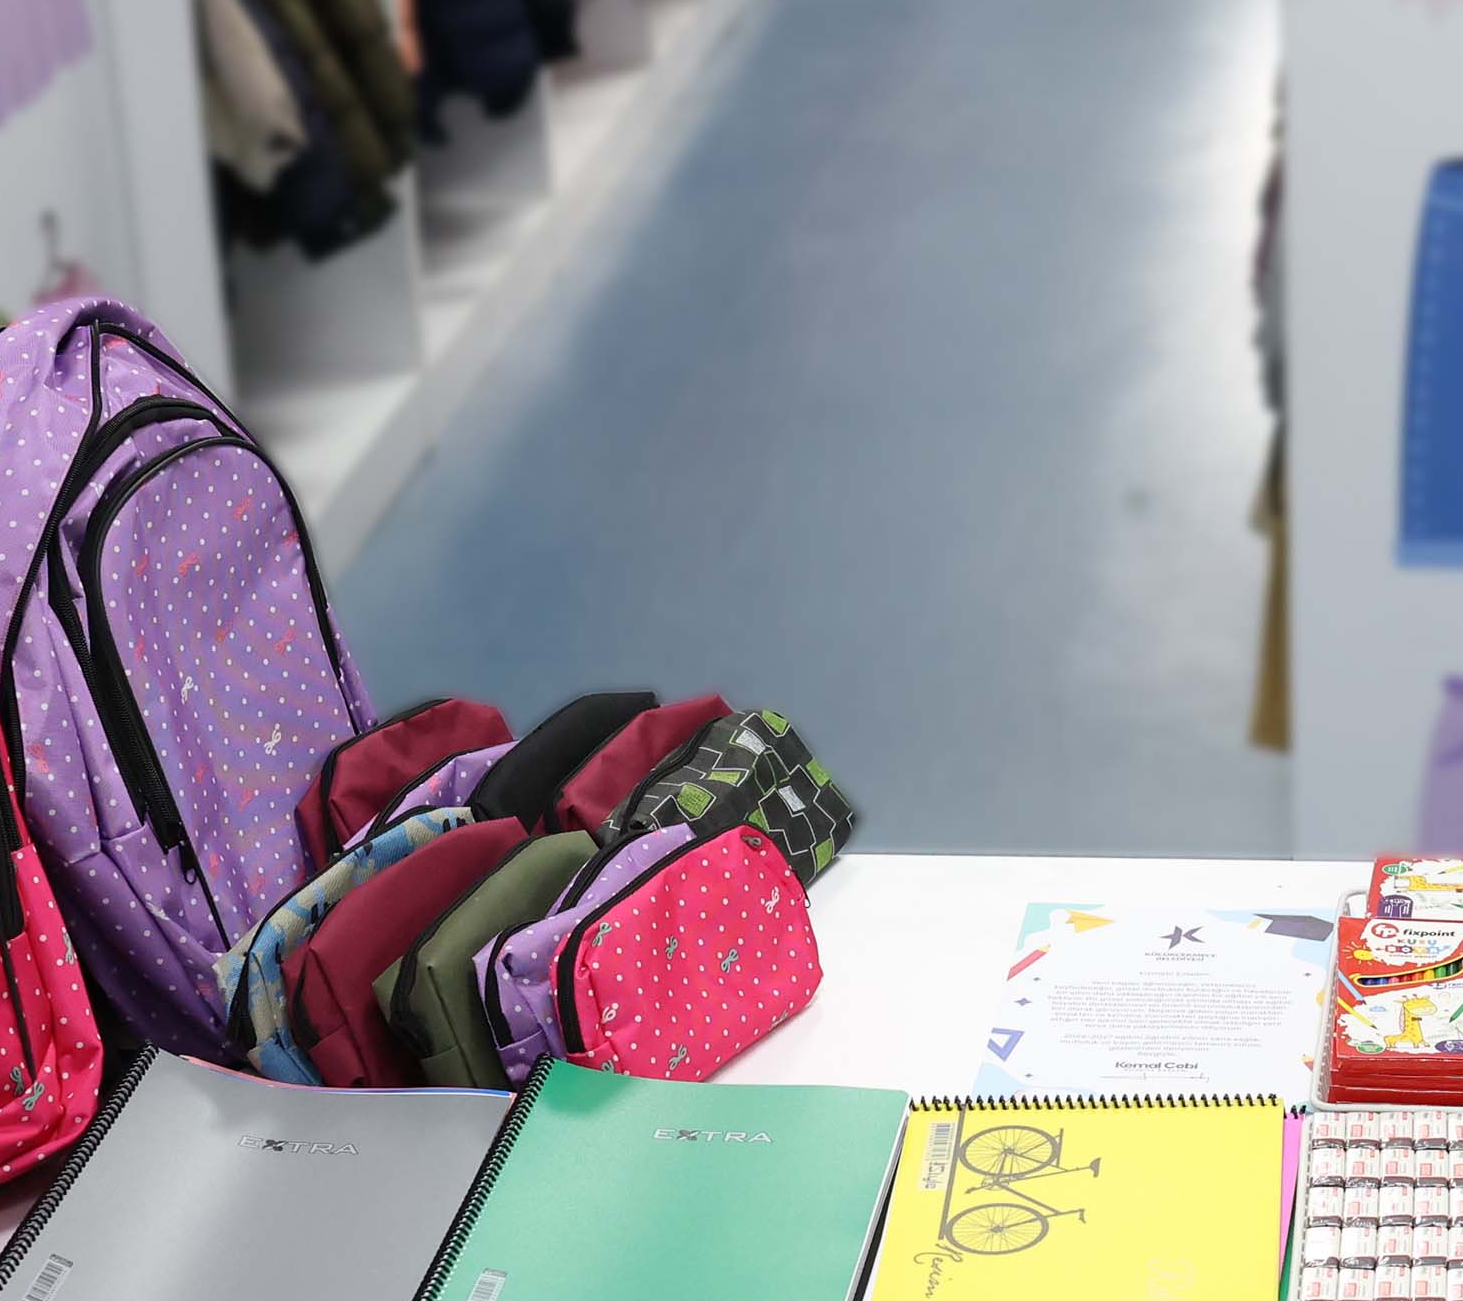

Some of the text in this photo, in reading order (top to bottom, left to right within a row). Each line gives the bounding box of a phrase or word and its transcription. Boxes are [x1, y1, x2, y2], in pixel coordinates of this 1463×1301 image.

[1402, 928, 1456, 938] fixpoint
[652, 1127, 774, 1143] EXTRA
[237, 1134, 360, 1155] EXTRA
